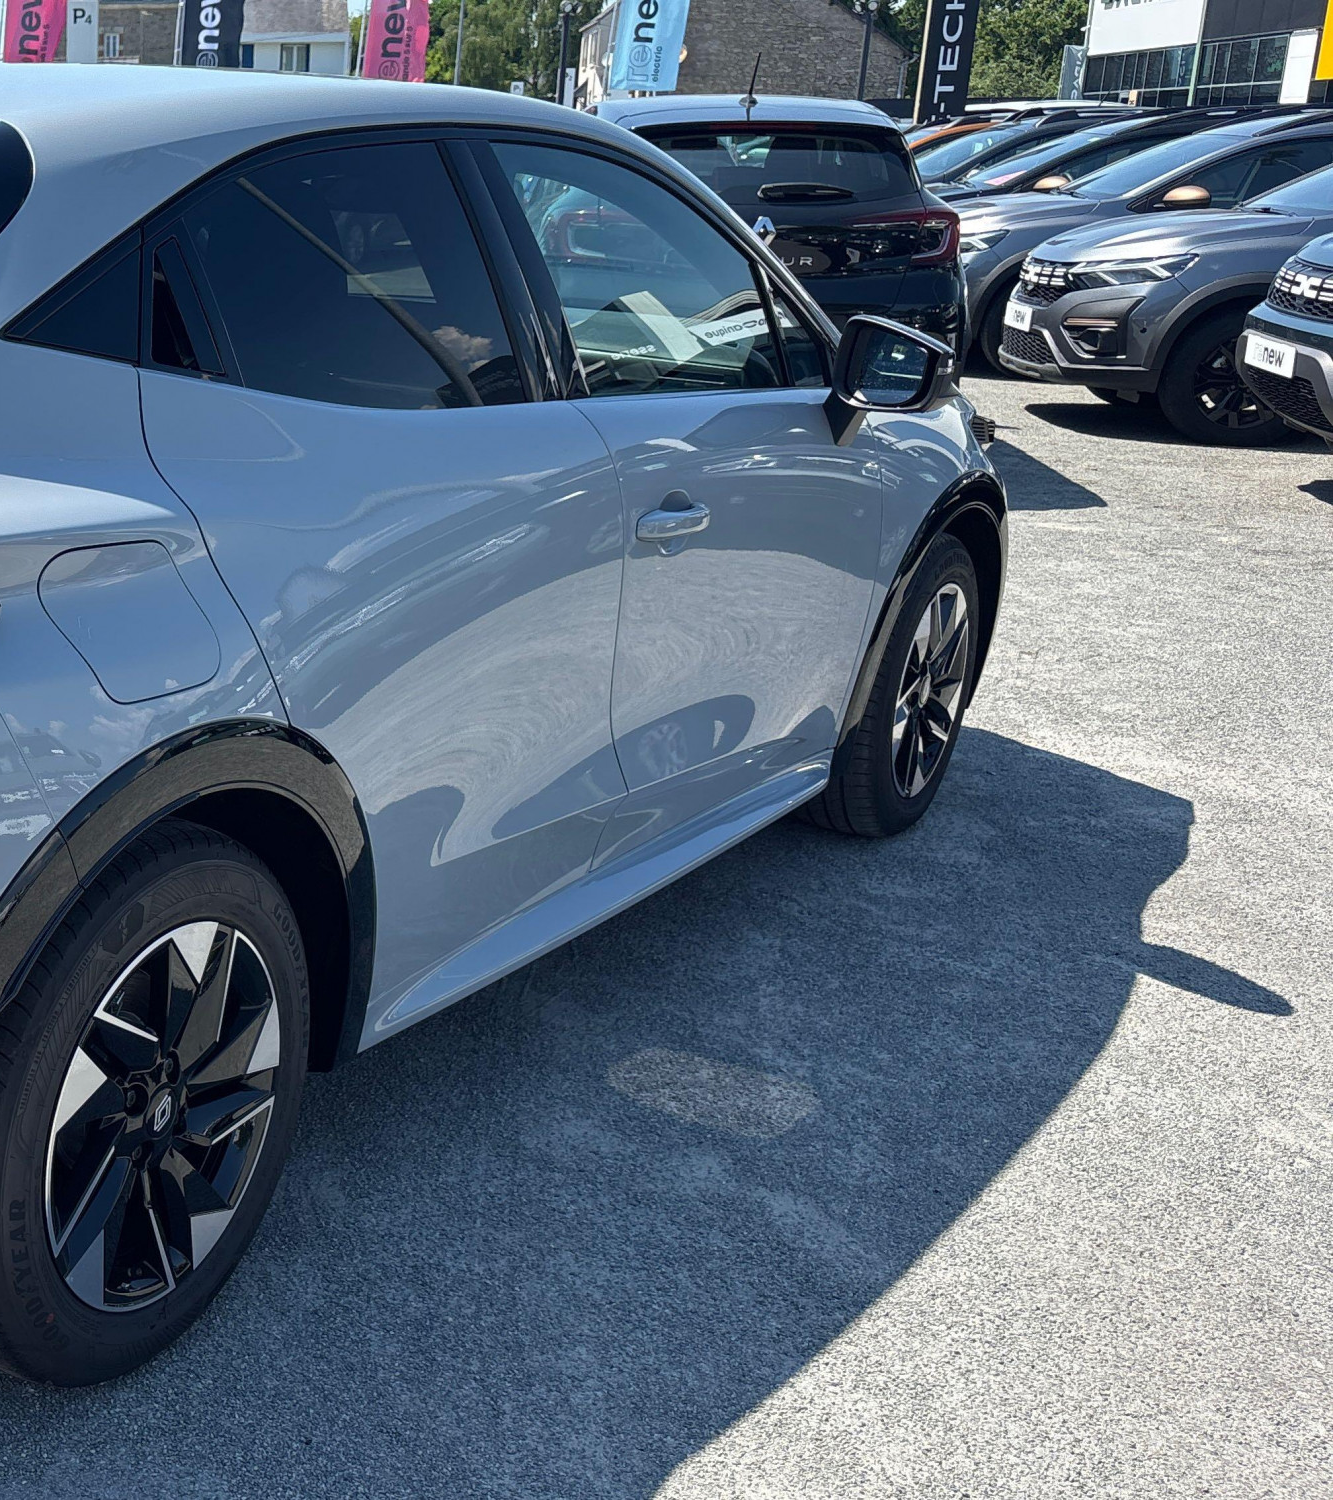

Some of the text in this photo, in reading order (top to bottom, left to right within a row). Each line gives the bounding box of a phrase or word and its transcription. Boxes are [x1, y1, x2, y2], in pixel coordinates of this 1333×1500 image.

[196, 0, 222, 67] ene
[378, 0, 408, 80] ene
[652, 45, 663, 82] electric
